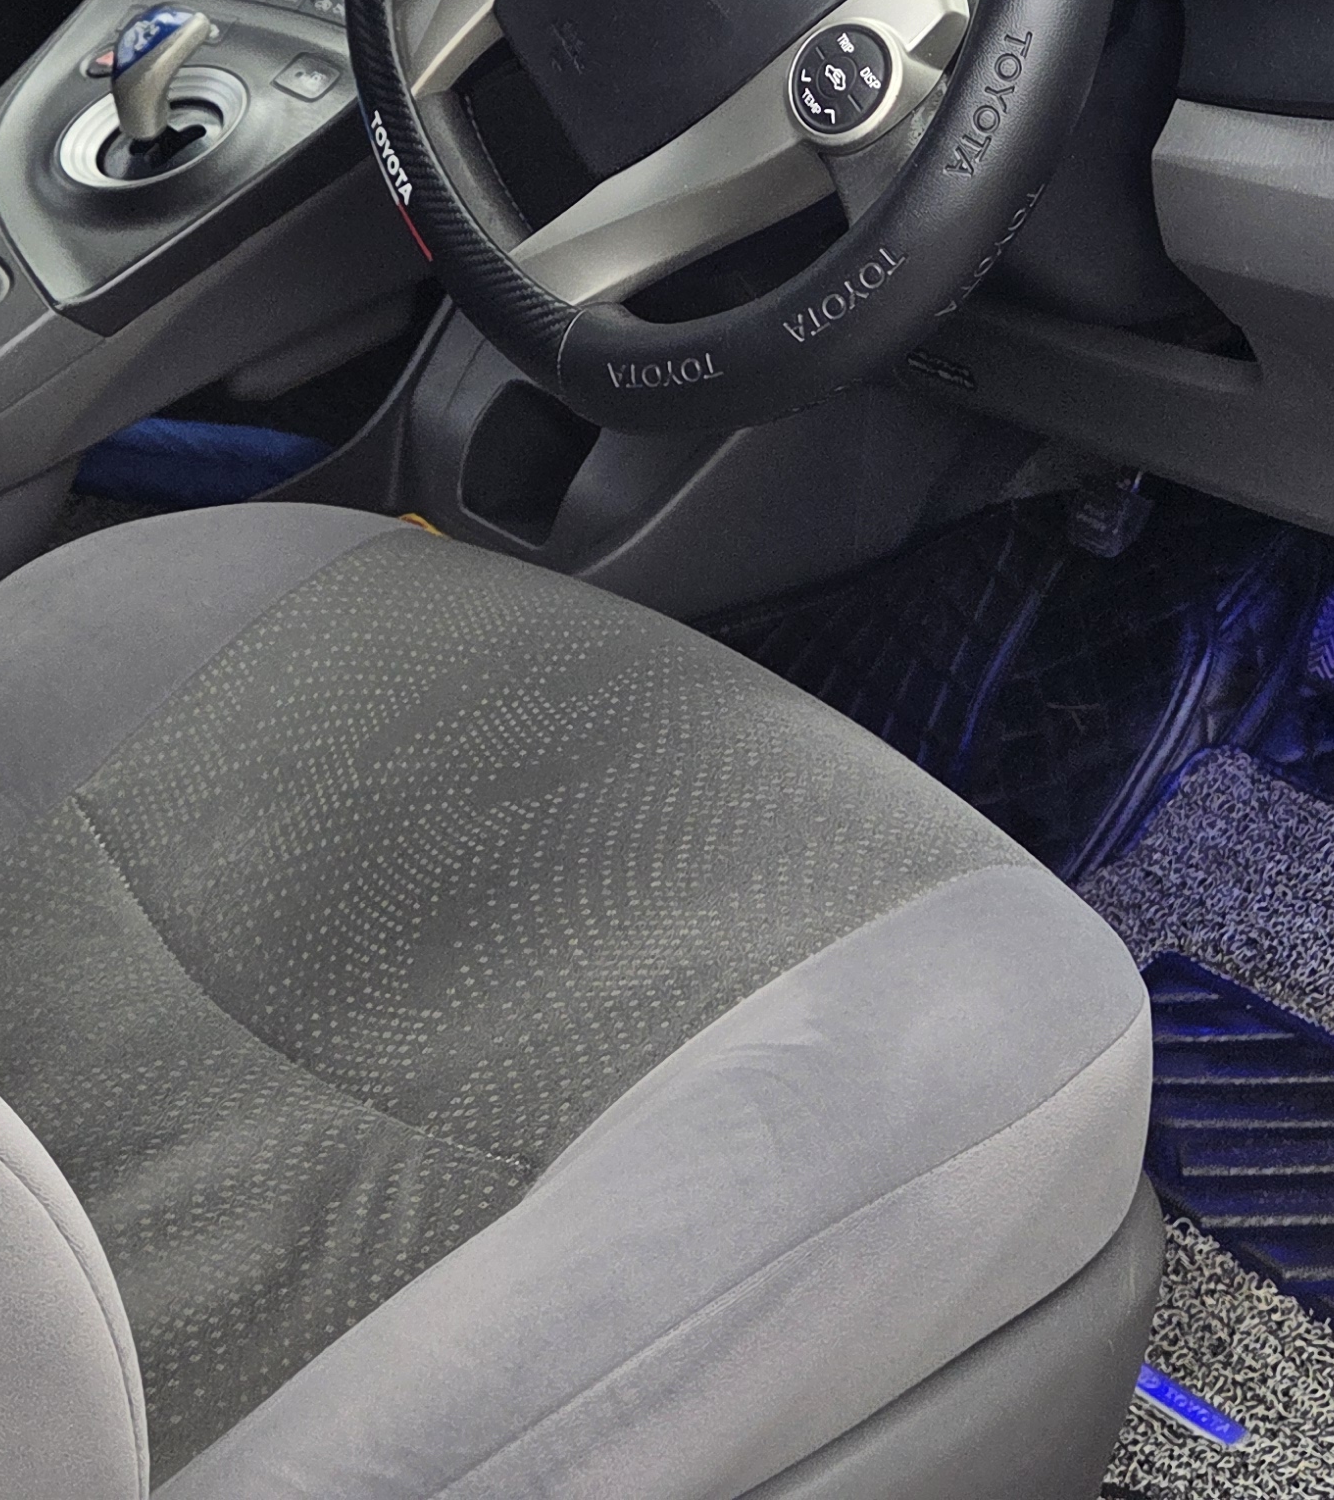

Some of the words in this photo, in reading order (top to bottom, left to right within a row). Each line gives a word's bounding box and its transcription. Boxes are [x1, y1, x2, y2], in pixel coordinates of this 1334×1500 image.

[836, 32, 855, 53] TRIP
[859, 66, 882, 90] DISP
[801, 87, 822, 115] TEMP
[943, 31, 1033, 178] TOYOTA
[370, 109, 413, 206] TOYOTA
[782, 247, 908, 343] TOYOTA
[606, 352, 724, 389] TOYOTA
[1165, 1386, 1231, 1434] TOYOTA
